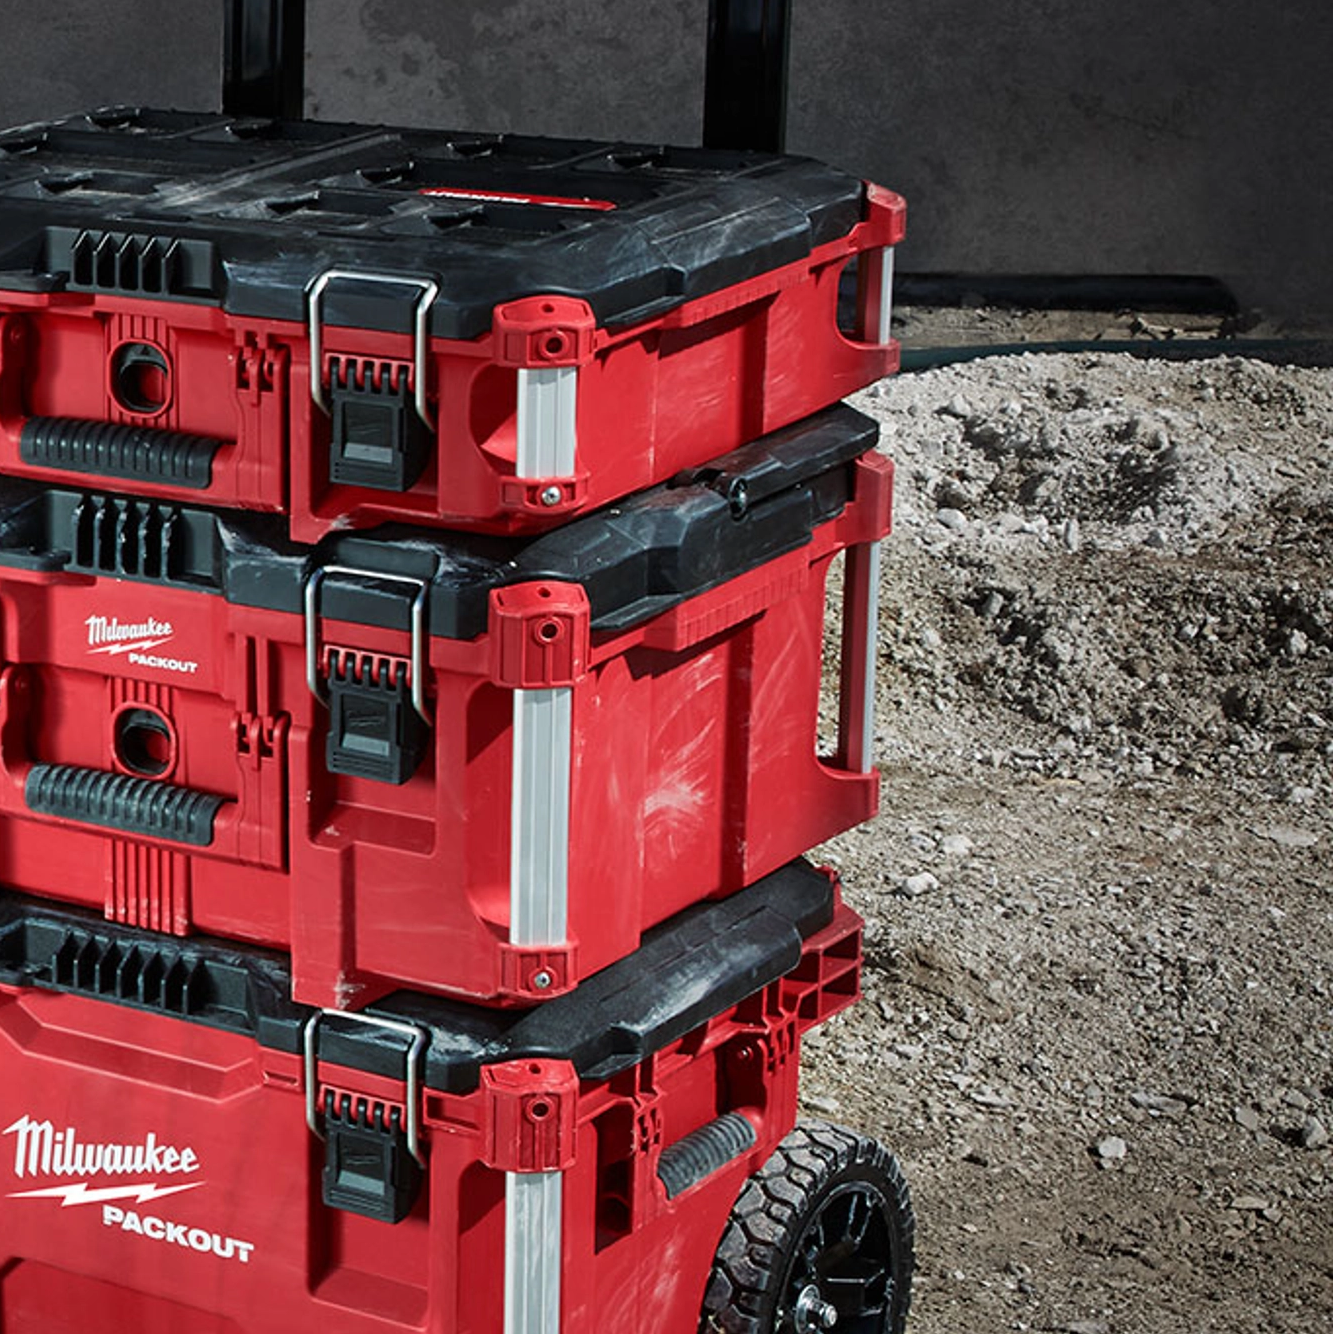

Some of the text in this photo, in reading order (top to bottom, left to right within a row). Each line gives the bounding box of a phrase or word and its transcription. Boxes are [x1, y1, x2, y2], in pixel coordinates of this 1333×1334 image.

[84, 614, 173, 646] Milwaukee
[128, 652, 198, 674] PACKOUT
[1, 1114, 200, 1179] Milwaukee
[102, 1204, 255, 1263] PACKOUT
